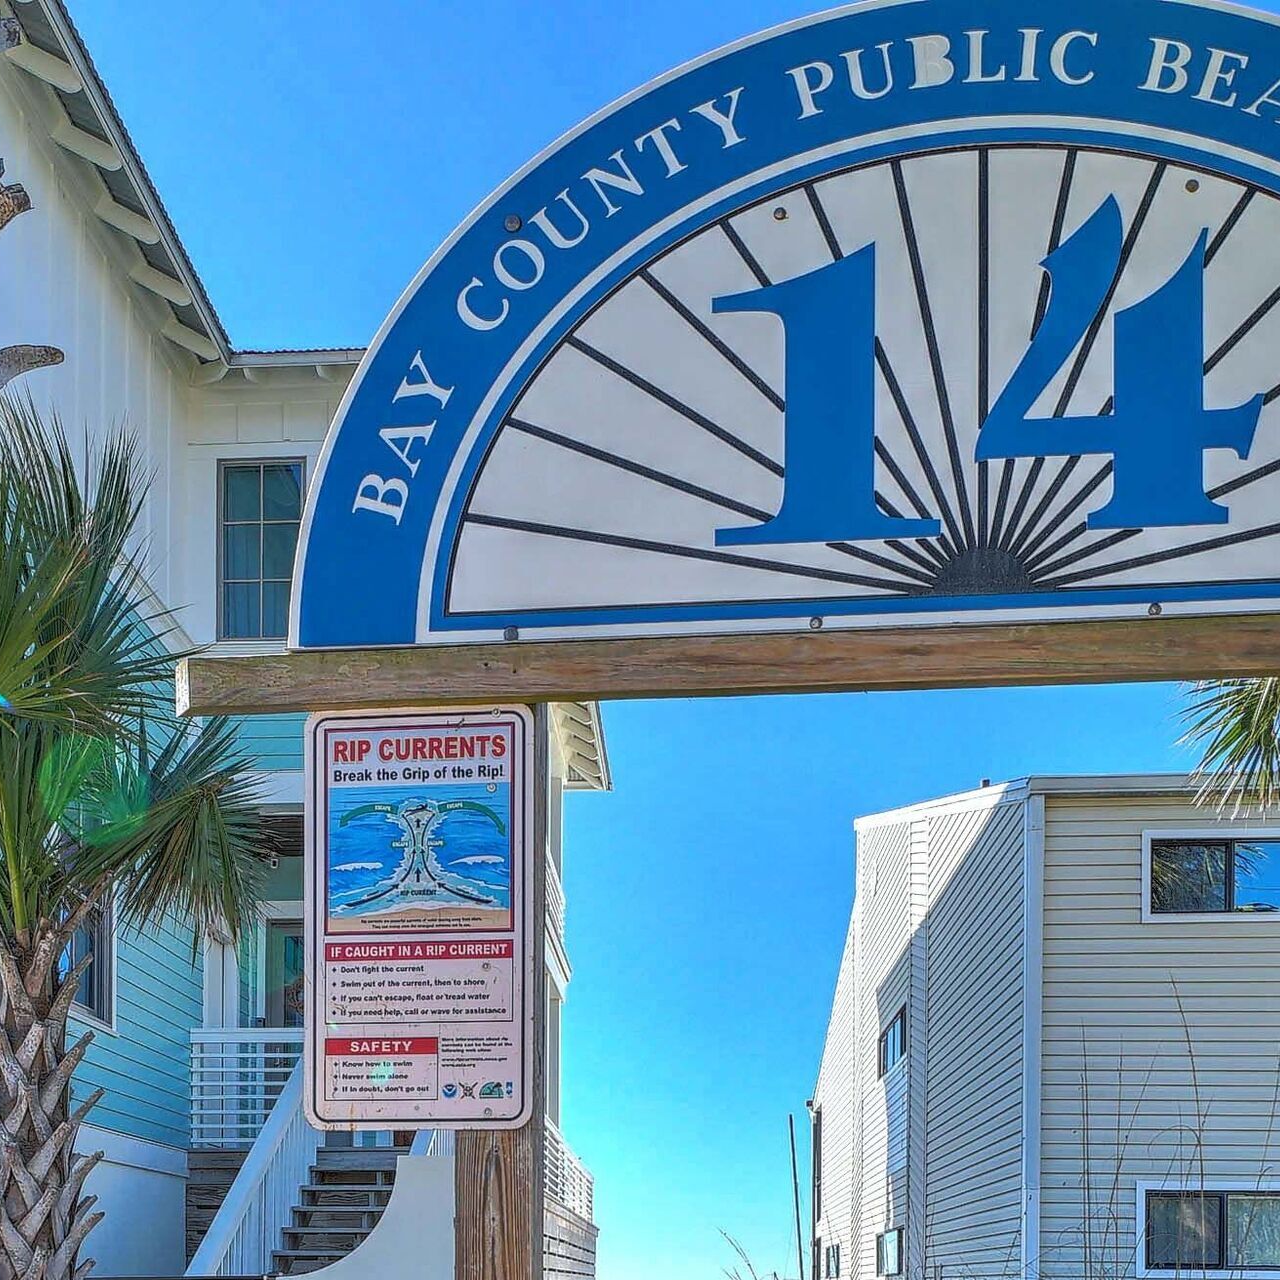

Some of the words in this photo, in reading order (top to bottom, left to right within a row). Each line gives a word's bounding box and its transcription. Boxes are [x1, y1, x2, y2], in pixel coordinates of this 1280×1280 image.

[352, 350, 455, 526] BAY
[457, 86, 747, 331] COUNTY
[784, 28, 1099, 120] PUBLIC
[712, 192, 1266, 547] 14
[333, 739, 371, 763] RIP
[378, 734, 507, 762] CURRENTS
[334, 767, 372, 782] Break
[377, 769, 398, 781] the
[402, 767, 430, 782] Grip
[433, 766, 448, 779] of
[451, 766, 474, 778] the
[478, 765, 504, 780] Rip!
[331, 946, 342, 958] IF
[345, 946, 395, 957] CAUGHT
[398, 945, 411, 957] IN
[414, 945, 423, 956] A
[426, 945, 446, 956] RIP
[449, 943, 508, 955] CURRENT
[362, 966, 380, 975] fight
[381, 965, 395, 973] the
[396, 965, 424, 973] current
[340, 980, 361, 988] Swim
[402, 979, 432, 988] current,
[463, 978, 486, 986] shore
[363, 994, 384, 1002] can't
[416, 993, 434, 1001] float
[348, 1010, 362, 1018] you
[350, 1041, 413, 1052] SAFETY
